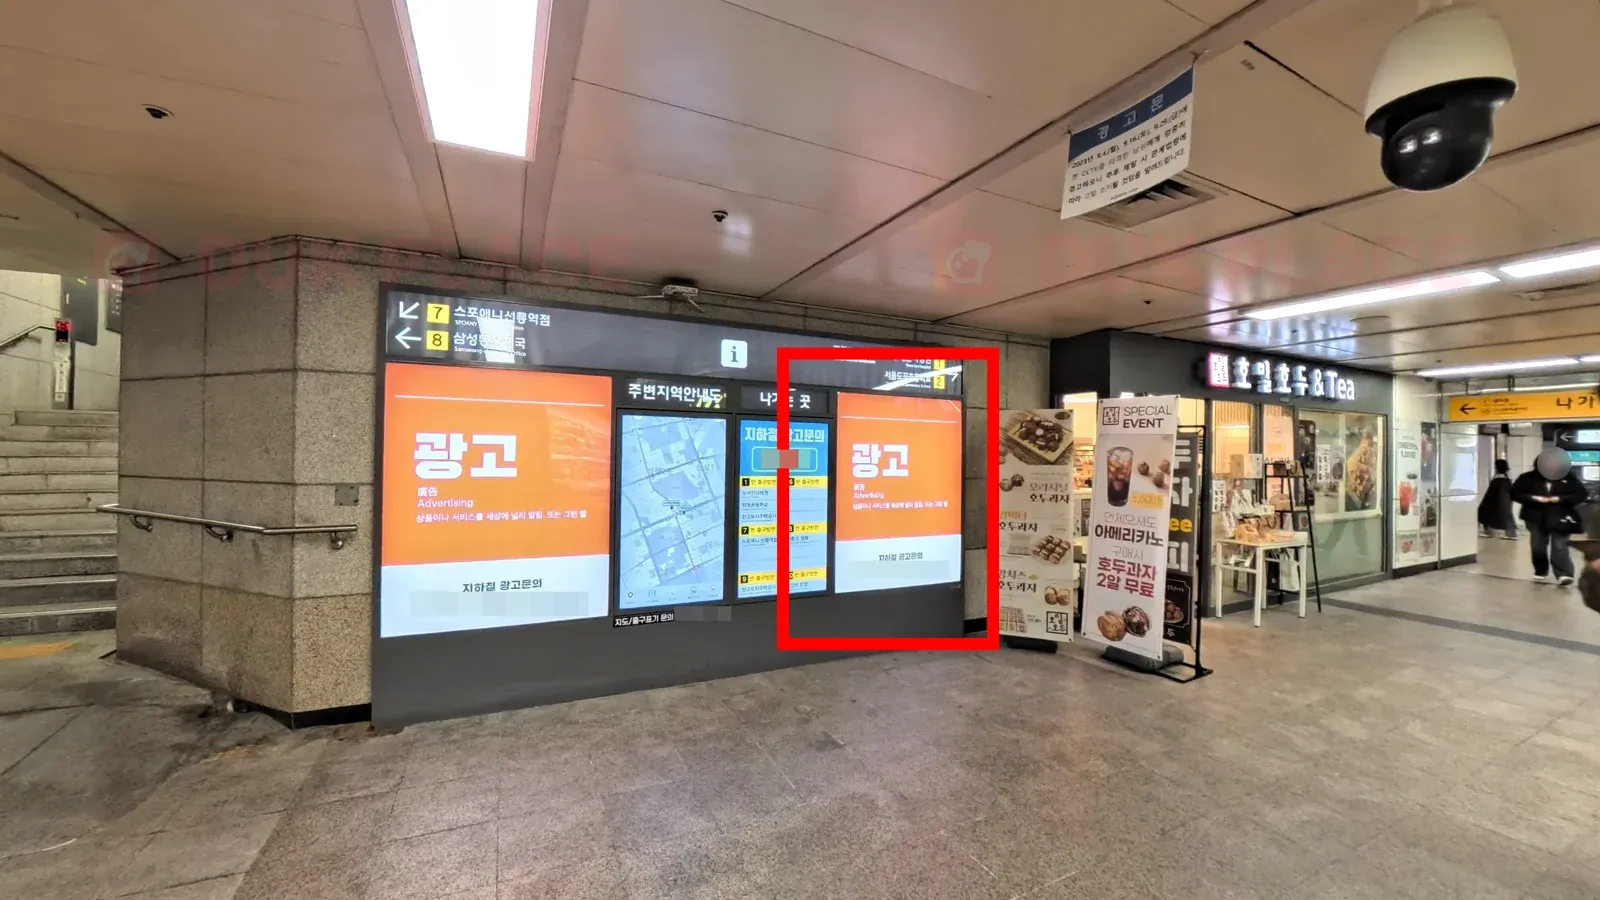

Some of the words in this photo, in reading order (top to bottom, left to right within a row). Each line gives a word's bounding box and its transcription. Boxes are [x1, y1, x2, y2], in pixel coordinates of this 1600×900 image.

[434, 306, 443, 319] 7
[432, 333, 442, 346] 8
[628, 383, 721, 402] 주변지역안내도
[800, 394, 811, 408] 곳
[1123, 405, 1172, 417] SPECIAL
[1122, 418, 1164, 428] EVENT
[414, 432, 518, 480] 광고
[852, 443, 909, 478] 광고
[417, 498, 474, 508] Advertising
[1094, 524, 1164, 548] 아메리카노
[1097, 556, 1157, 581] 호두과자
[462, 581, 496, 592] 지하철
[500, 578, 542, 591] 광고문의
[1096, 573, 1122, 590] 2알
[1124, 578, 1155, 598] 무료
[614, 614, 659, 626] 지도/출구표기
[660, 613, 674, 622] 문의
